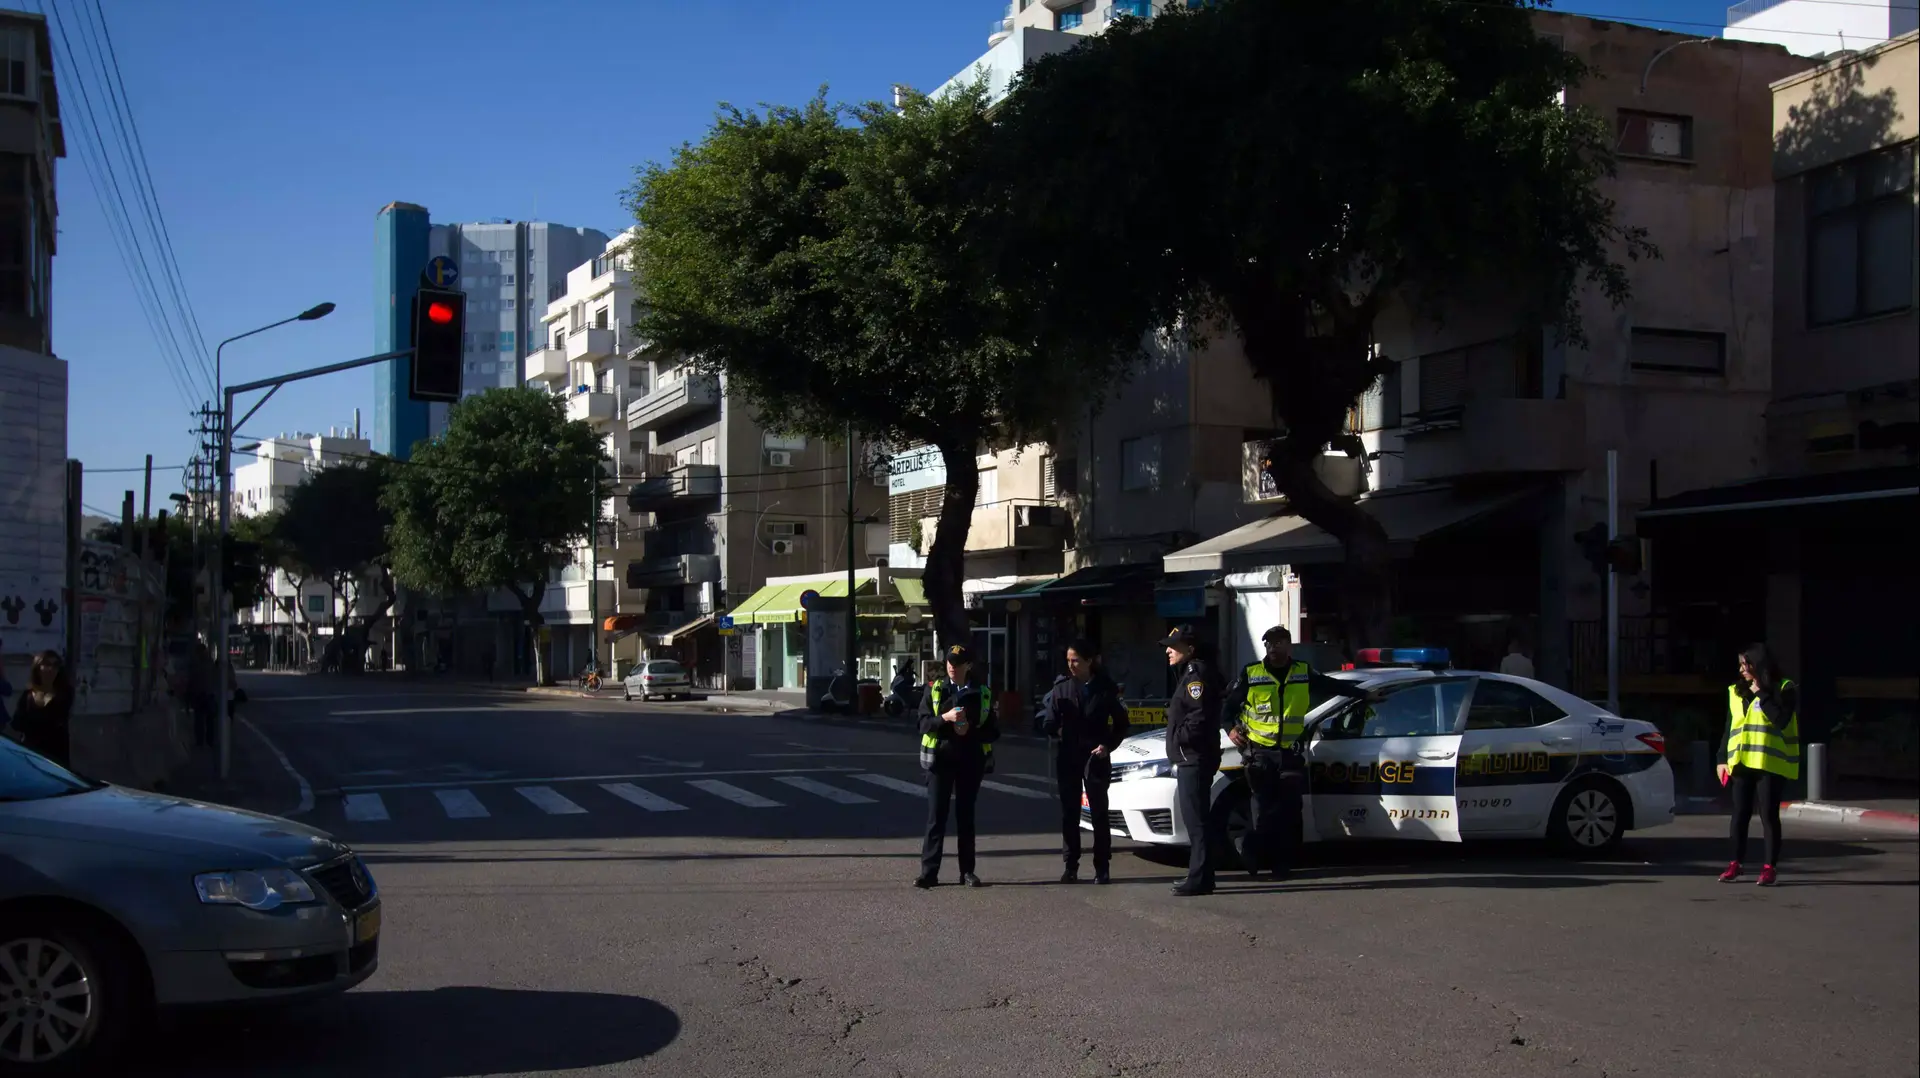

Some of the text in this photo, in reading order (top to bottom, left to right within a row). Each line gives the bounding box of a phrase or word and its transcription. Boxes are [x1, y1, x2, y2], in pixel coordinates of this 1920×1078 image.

[891, 457, 923, 475] ARTPLUS
[891, 478, 906, 488] HOTEL
[1310, 760, 1415, 784] POLICE
[1389, 798, 1512, 819] משטרת התנועה
